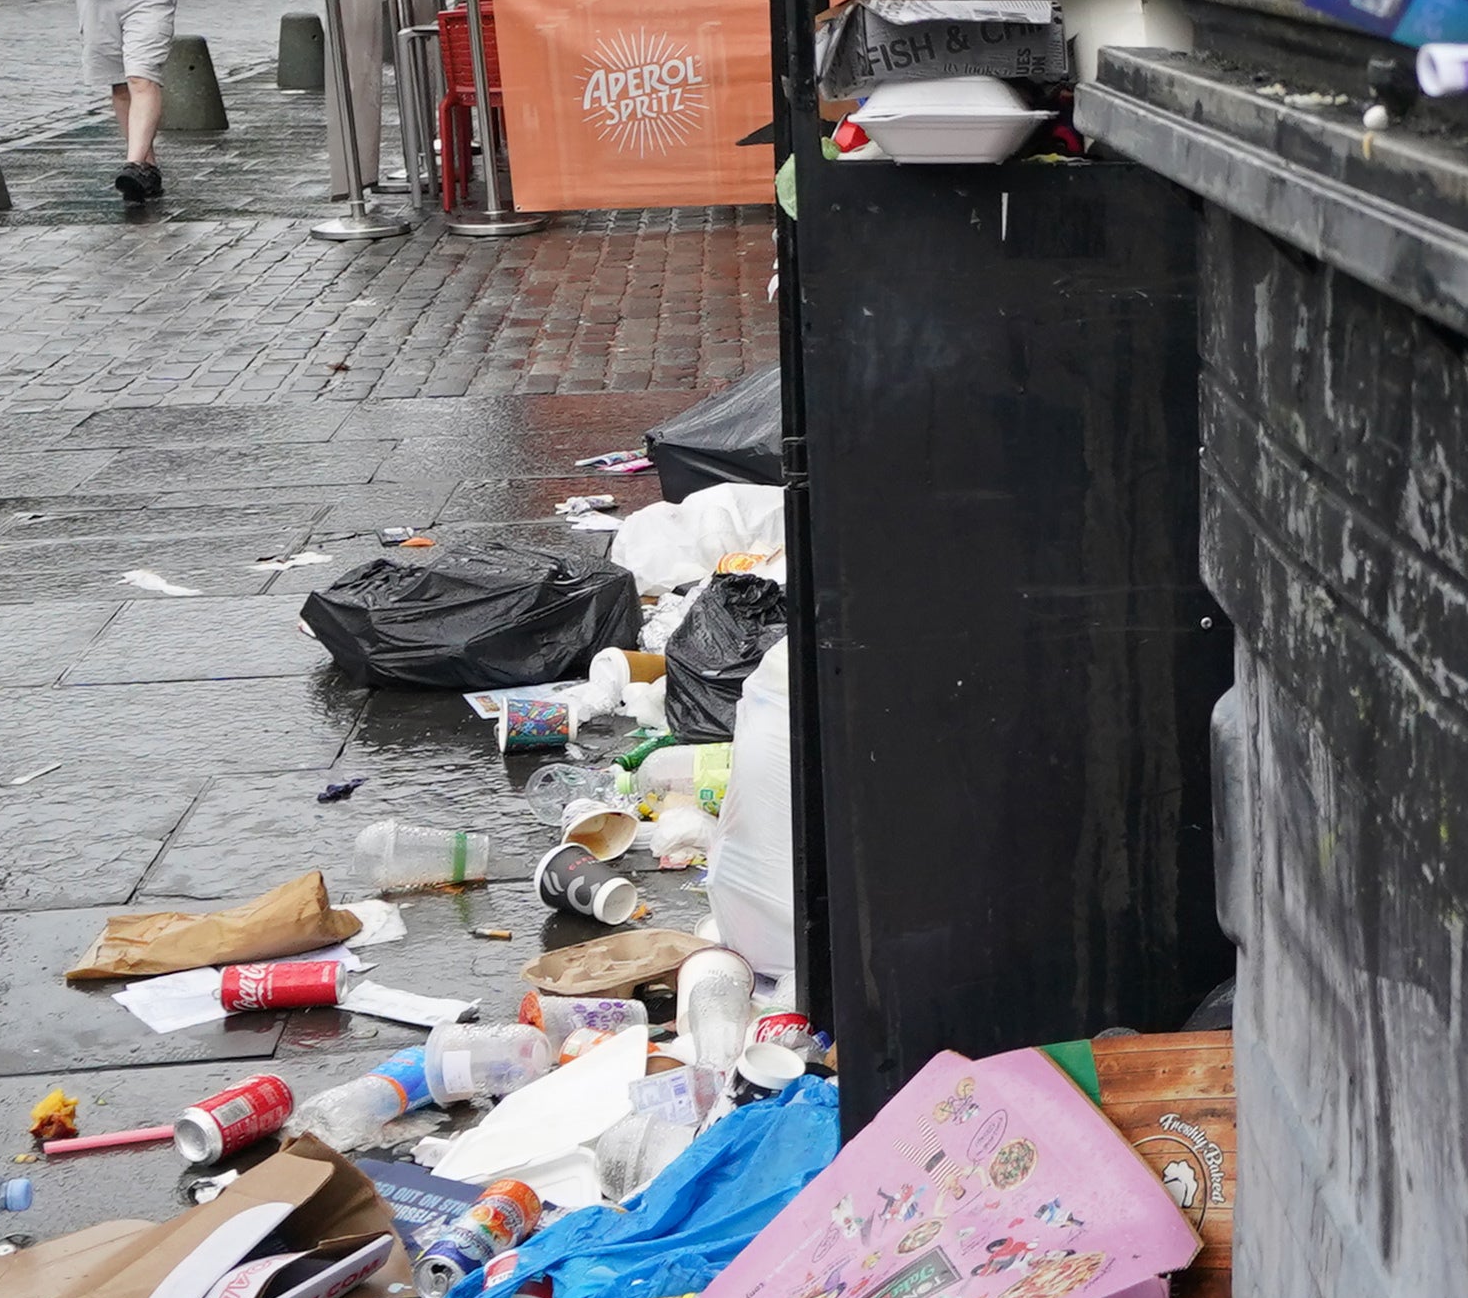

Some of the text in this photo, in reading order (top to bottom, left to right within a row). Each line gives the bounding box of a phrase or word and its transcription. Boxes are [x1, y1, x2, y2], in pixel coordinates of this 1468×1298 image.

[863, 33, 936, 76] FISH
[945, 25, 972, 54] &
[583, 56, 703, 110] APEROL
[1159, 1113, 1209, 1152] Freshly
[1203, 1142, 1225, 1205] Baked
